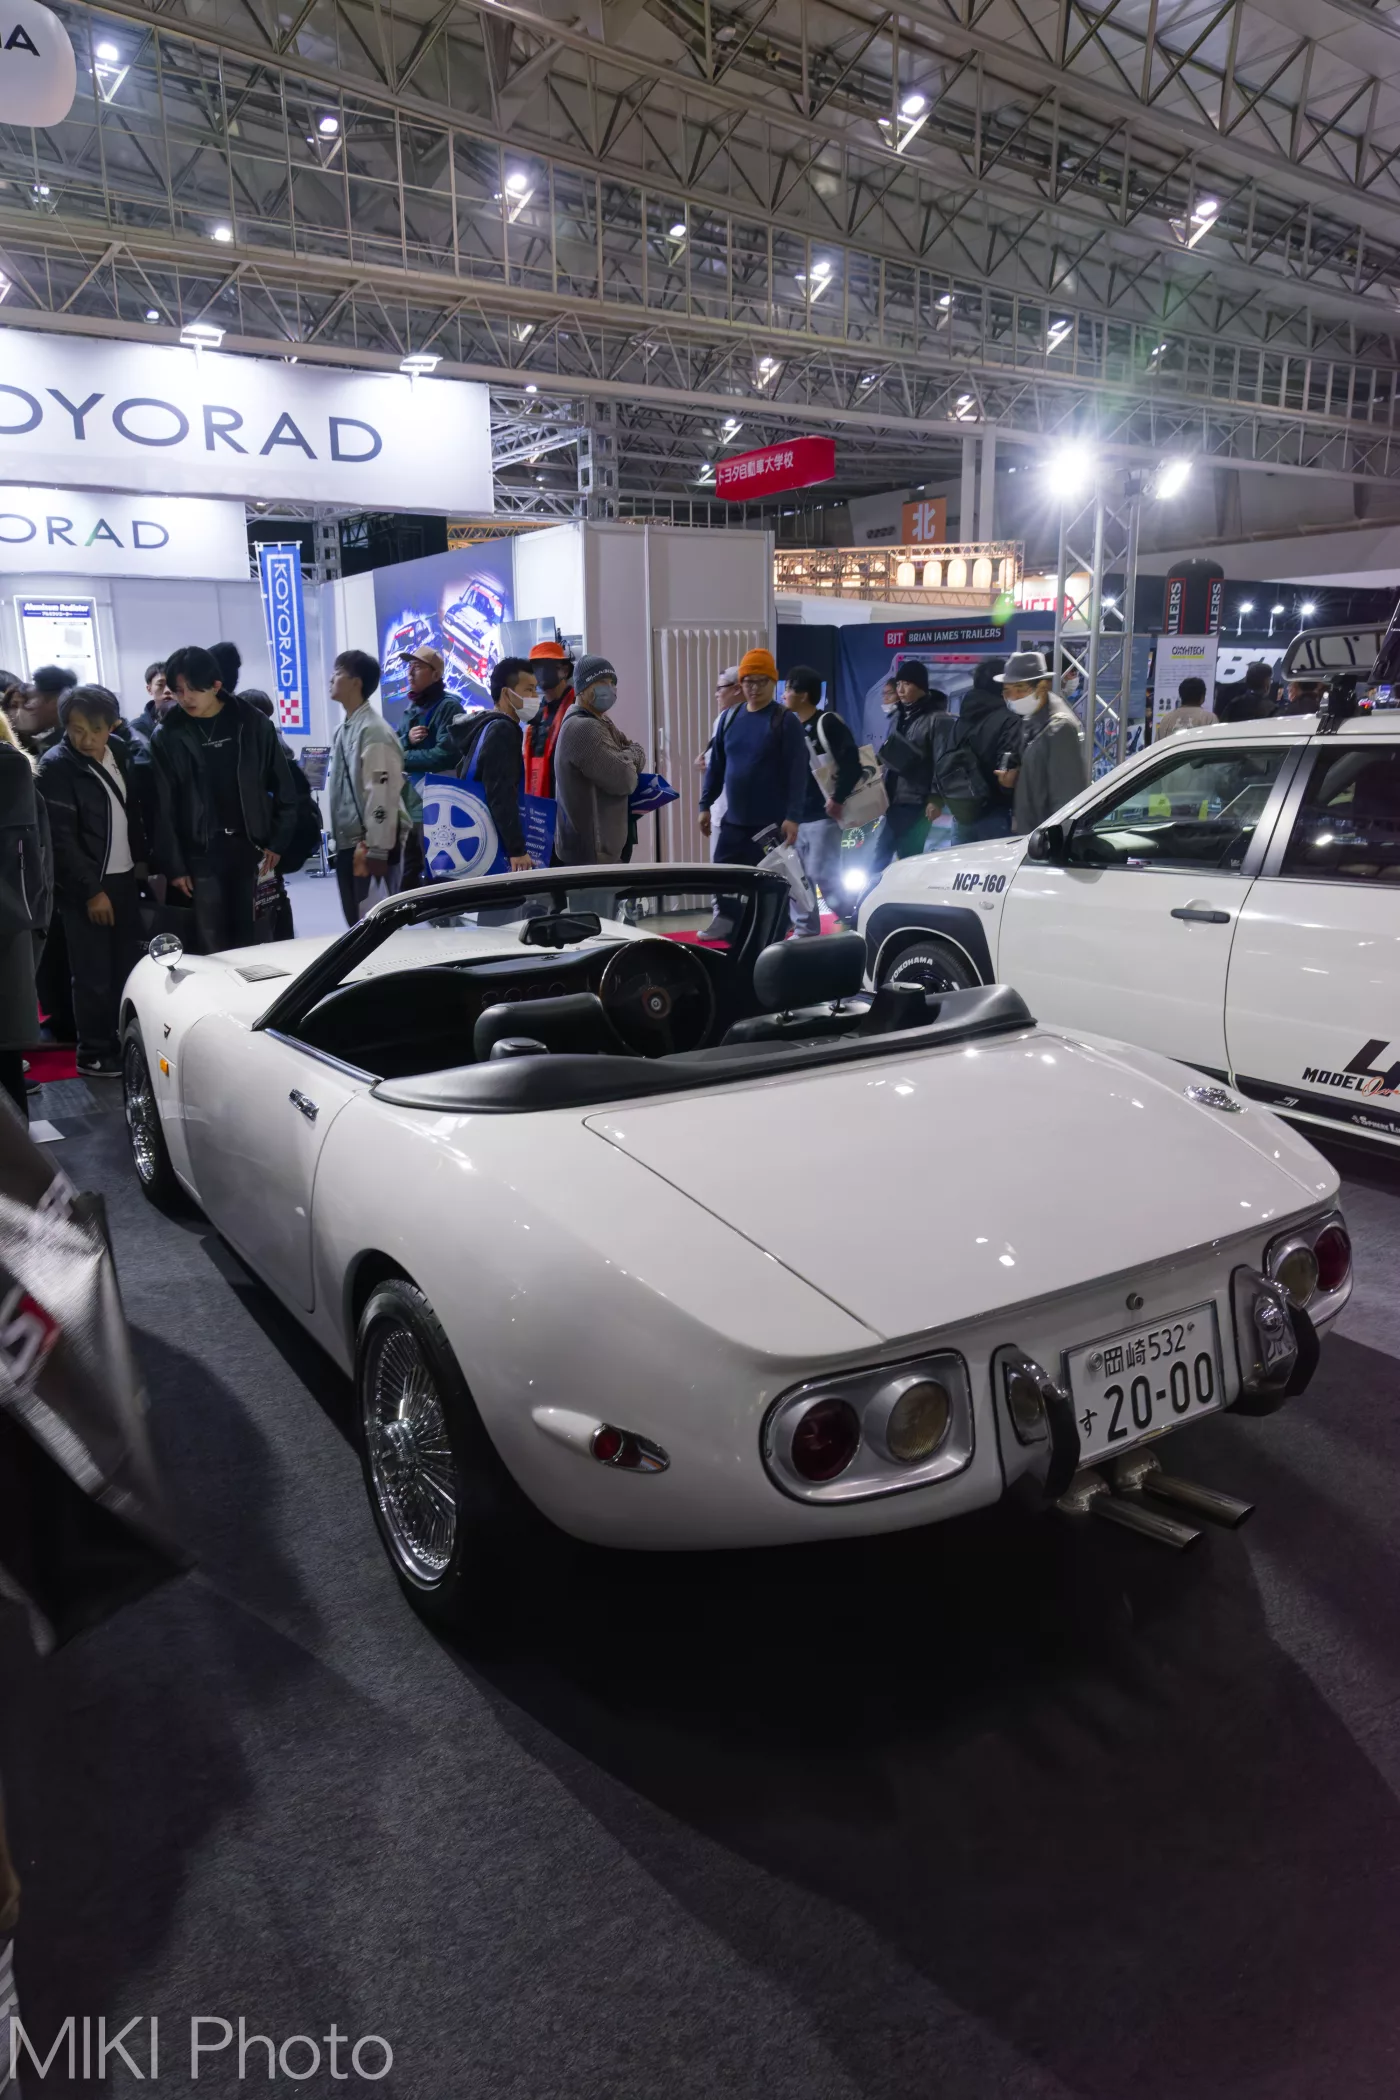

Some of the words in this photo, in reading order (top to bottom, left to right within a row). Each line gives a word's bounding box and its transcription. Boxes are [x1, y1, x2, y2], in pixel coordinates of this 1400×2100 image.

[718, 451, 794, 485] トヨタ自動車大学校
[912, 503, 936, 541] 北
[274, 563, 293, 687] KOYORAD
[908, 630, 932, 643] BRIAN
[933, 630, 959, 643] JAMES
[960, 627, 1001, 641] TRAILERS
[952, 873, 1007, 893] NCP-160
[1302, 1067, 1366, 1093] MODEL
